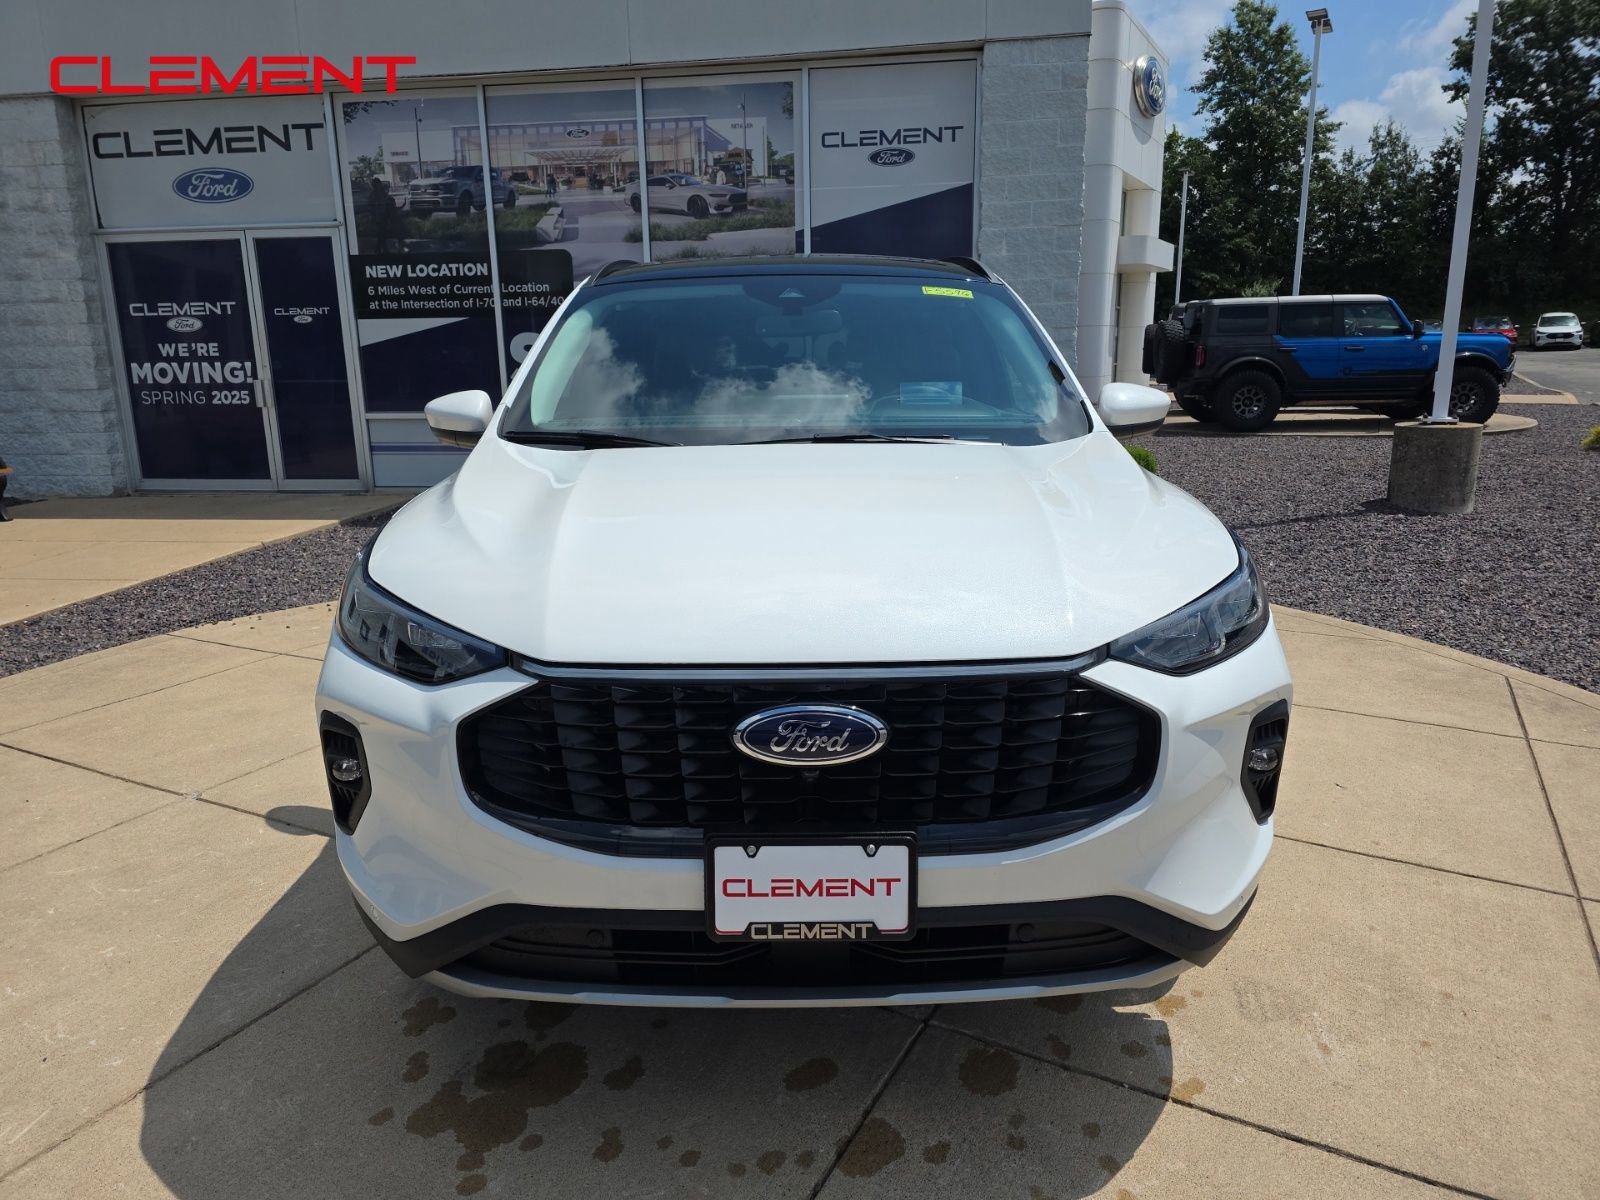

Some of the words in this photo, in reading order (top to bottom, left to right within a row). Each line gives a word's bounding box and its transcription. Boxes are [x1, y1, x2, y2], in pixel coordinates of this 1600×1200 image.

[92, 123, 324, 159] CLEMENT
[821, 125, 964, 148] CLEMENT
[877, 150, 906, 164] Ford
[188, 173, 238, 198] Ford
[365, 265, 402, 278] NEW
[407, 263, 489, 277] LOCATION
[368, 286, 375, 295] 6
[378, 285, 406, 295] Miles
[408, 284, 437, 294] West
[439, 284, 451, 294] of
[502, 282, 550, 293] Location
[129, 301, 236, 316] CLEMENT
[369, 301, 380, 310] at
[381, 300, 399, 309] the
[401, 298, 461, 309] Intersection
[463, 299, 474, 308] of
[503, 297, 522, 307] and
[274, 307, 330, 316] CLEMENT
[157, 342, 220, 357] WE'RE
[130, 361, 254, 384] MOVING!
[141, 390, 206, 404] SPRING
[211, 390, 250, 405] 2025
[769, 719, 852, 753] Ford
[722, 878, 901, 898] CLEMENT
[750, 923, 874, 940] CLEMENT
